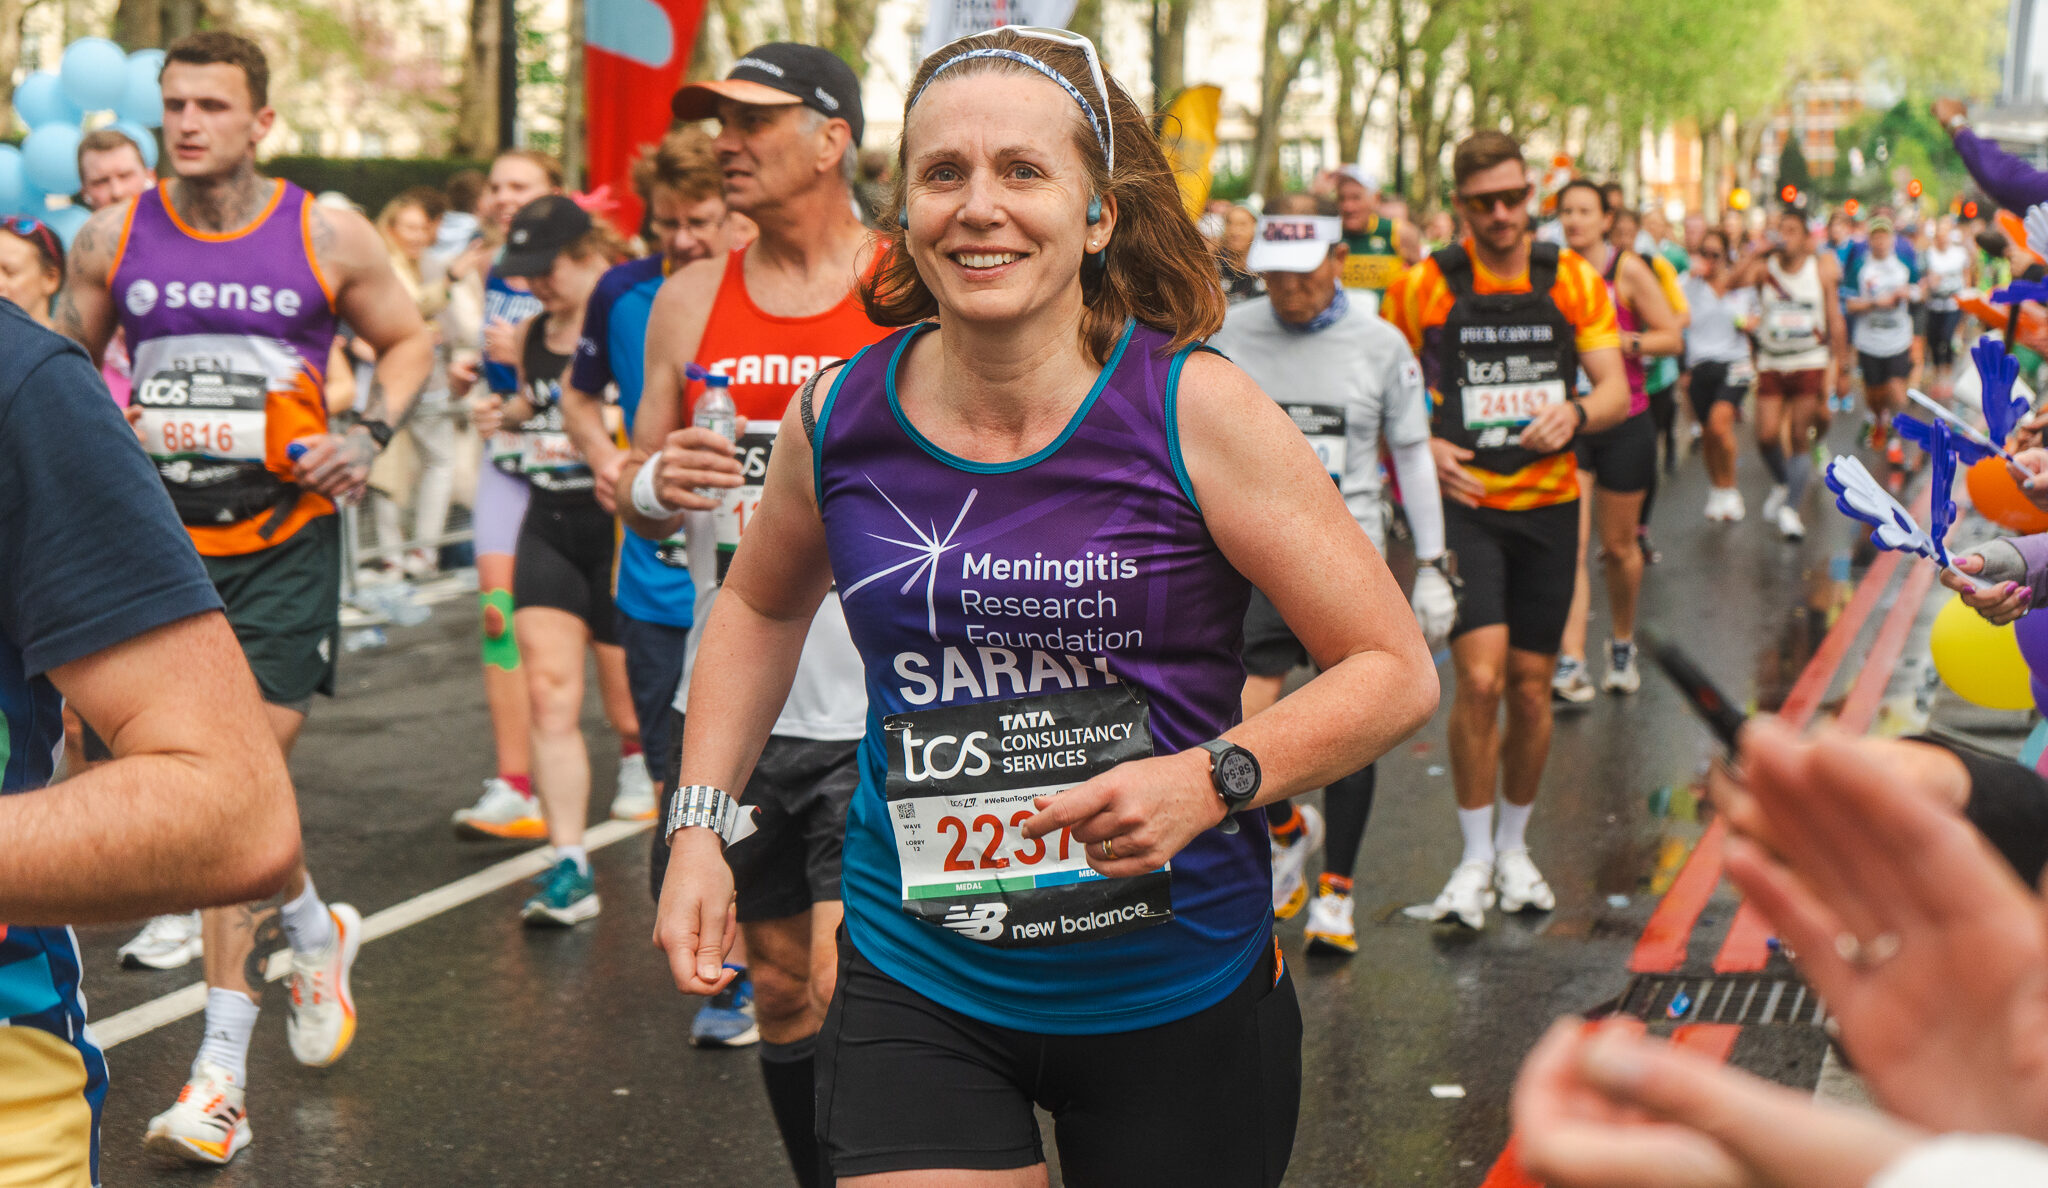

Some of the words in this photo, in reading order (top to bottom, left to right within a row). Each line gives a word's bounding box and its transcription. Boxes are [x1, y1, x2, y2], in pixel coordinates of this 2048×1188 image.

[164, 281, 302, 317] sense
[1467, 358, 1506, 384] tcs
[139, 378, 189, 405] tcs
[163, 421, 233, 452] 8816
[961, 552, 1138, 588] Meningitis
[960, 590, 1117, 618] Research
[966, 625, 1143, 653] Foundation
[893, 646, 1118, 705] SARAH
[998, 710, 1056, 731] TATA
[1001, 722, 1134, 752] CONSULTANCY
[902, 728, 991, 782] tcs
[1003, 748, 1088, 774] SERVICES
[955, 882, 983, 891] MEDAL
[1078, 869, 1100, 878] MED
[1011, 920, 1057, 940] new
[1060, 902, 1149, 934] balance
